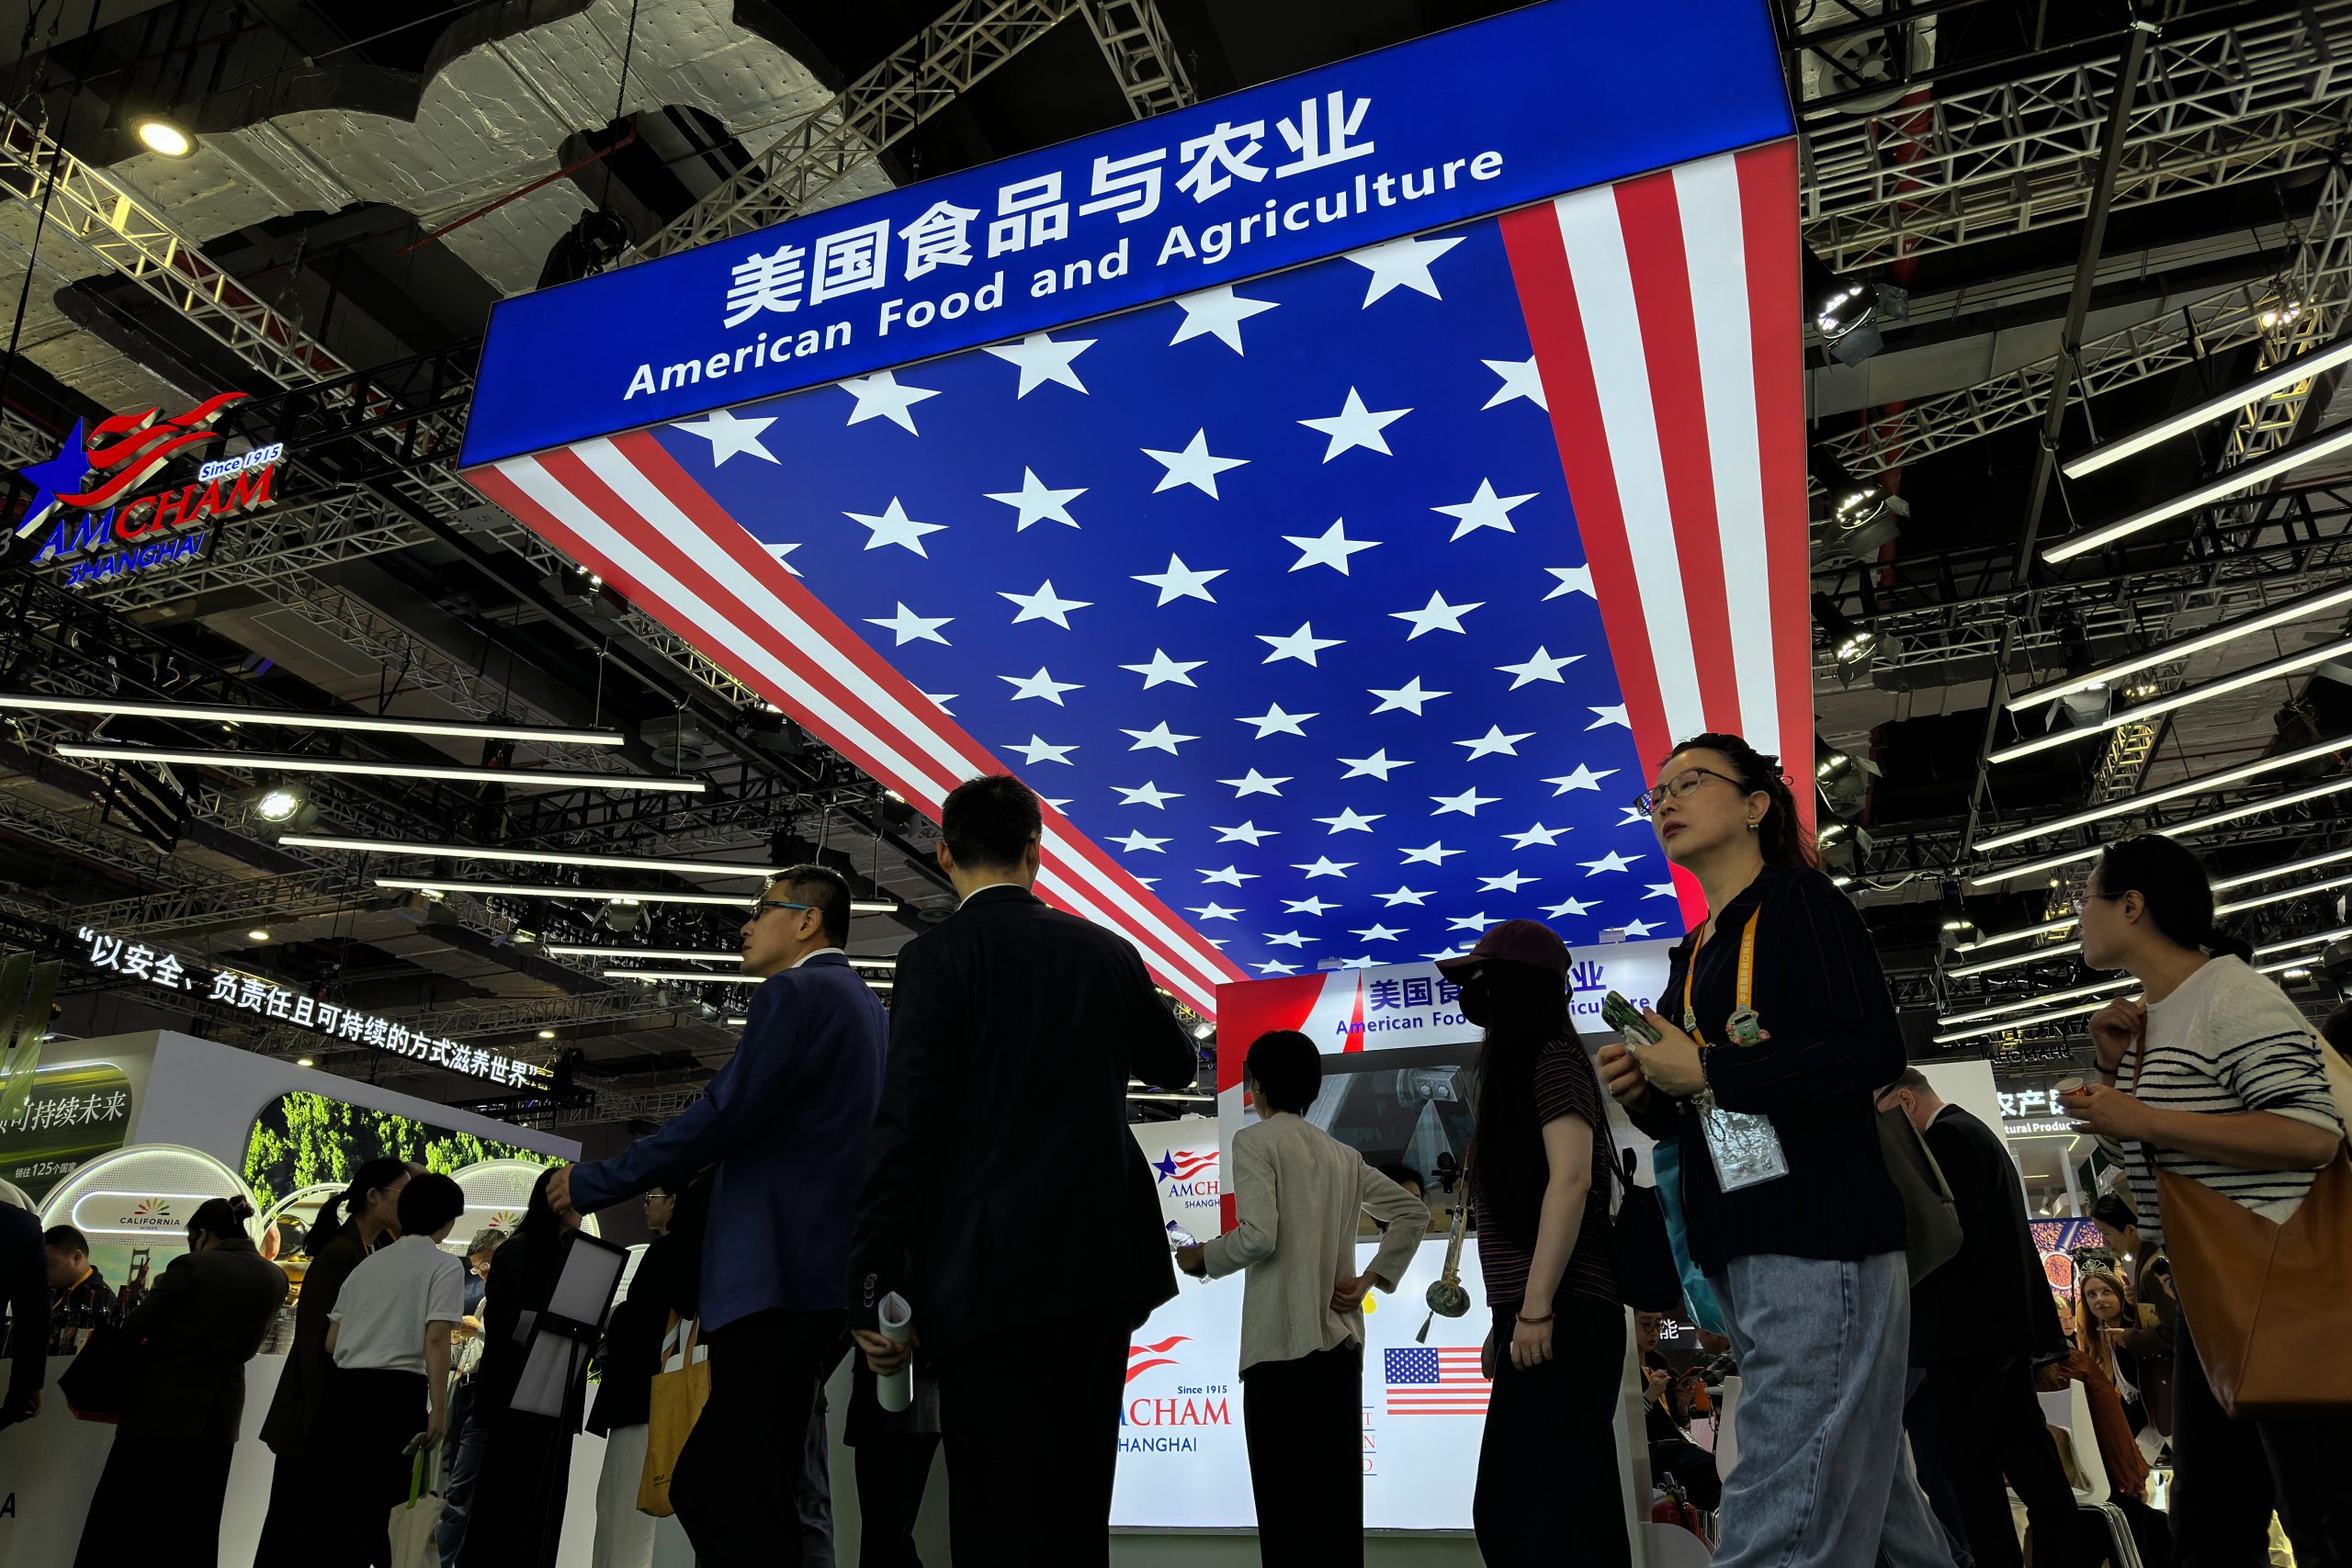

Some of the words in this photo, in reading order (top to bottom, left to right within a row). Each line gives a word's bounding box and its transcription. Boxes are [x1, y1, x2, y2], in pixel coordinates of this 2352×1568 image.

[724, 90, 1375, 329] 美国食品与农业
[623, 320, 852, 400] American
[878, 271, 1004, 337] Food
[1030, 238, 1128, 297] and
[1157, 150, 1503, 265] Agriculture
[200, 458, 241, 479] Since
[245, 445, 279, 467] 1915
[30, 462, 275, 564] AMCHAM
[66, 531, 205, 586] SHANGHAI
[1336, 1015, 1423, 1035] American
[1432, 1010, 1466, 1027] Foo
[1168, 1180, 1219, 1198] AMCH
[1184, 1200, 1220, 1209] SHANGH
[119, 1217, 180, 1225] CALIFORNIA
[1177, 1385, 1203, 1394] Since
[1206, 1385, 1227, 1393] 1915
[1121, 1396, 1232, 1426] CHAM
[1118, 1437, 1197, 1452] HANGHAI
